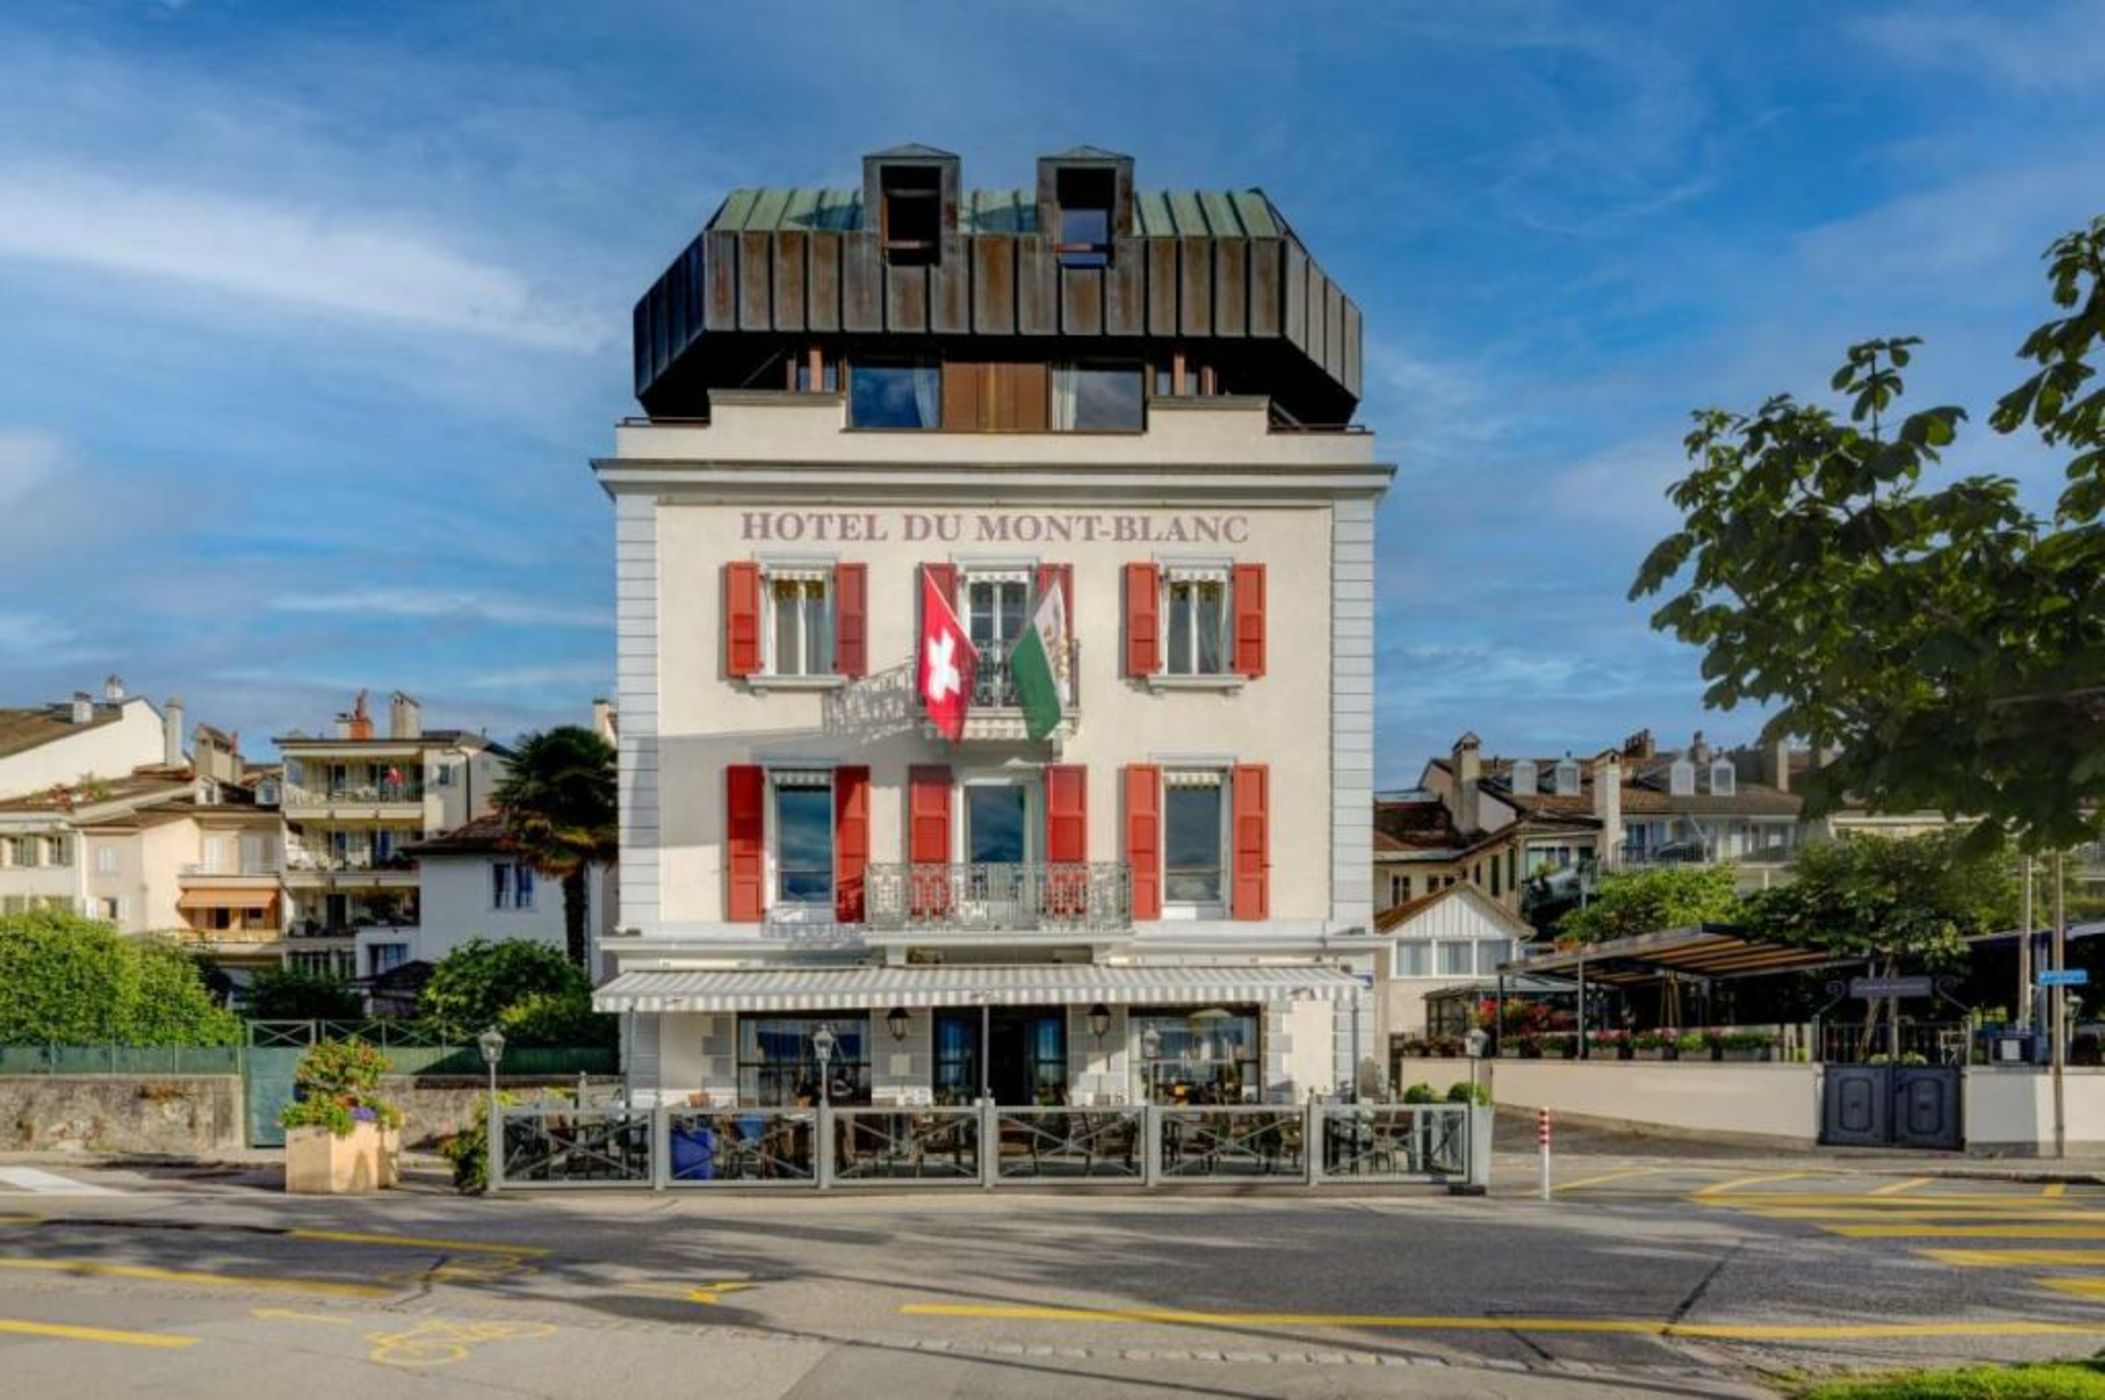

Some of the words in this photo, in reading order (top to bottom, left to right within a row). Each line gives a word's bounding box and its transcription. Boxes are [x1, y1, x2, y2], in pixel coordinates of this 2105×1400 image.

[741, 512, 888, 541] HOTEL
[903, 514, 962, 541] DU
[976, 515, 1249, 542] MONT-BLANC
